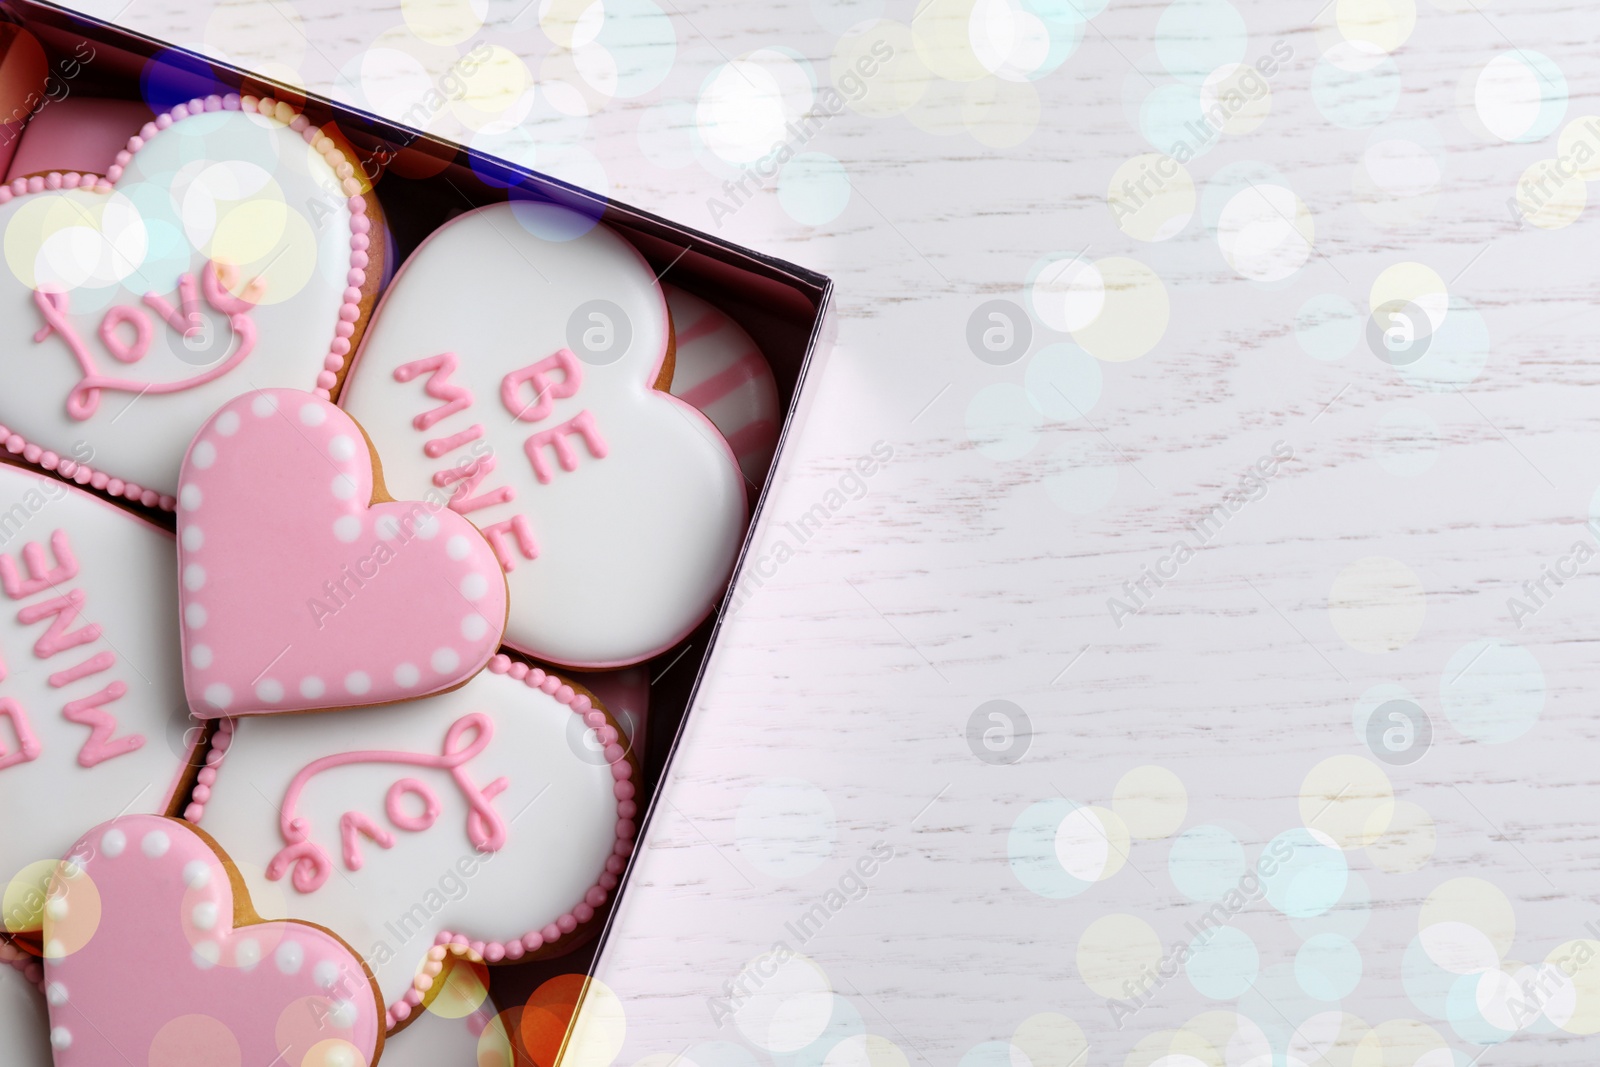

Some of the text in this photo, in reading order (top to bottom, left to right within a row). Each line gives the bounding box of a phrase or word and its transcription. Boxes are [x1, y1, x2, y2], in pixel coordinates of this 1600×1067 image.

[34, 256, 268, 421] Love
[500, 348, 609, 485] BE
[0, 527, 147, 768] MINE
[265, 712, 510, 894] Love
